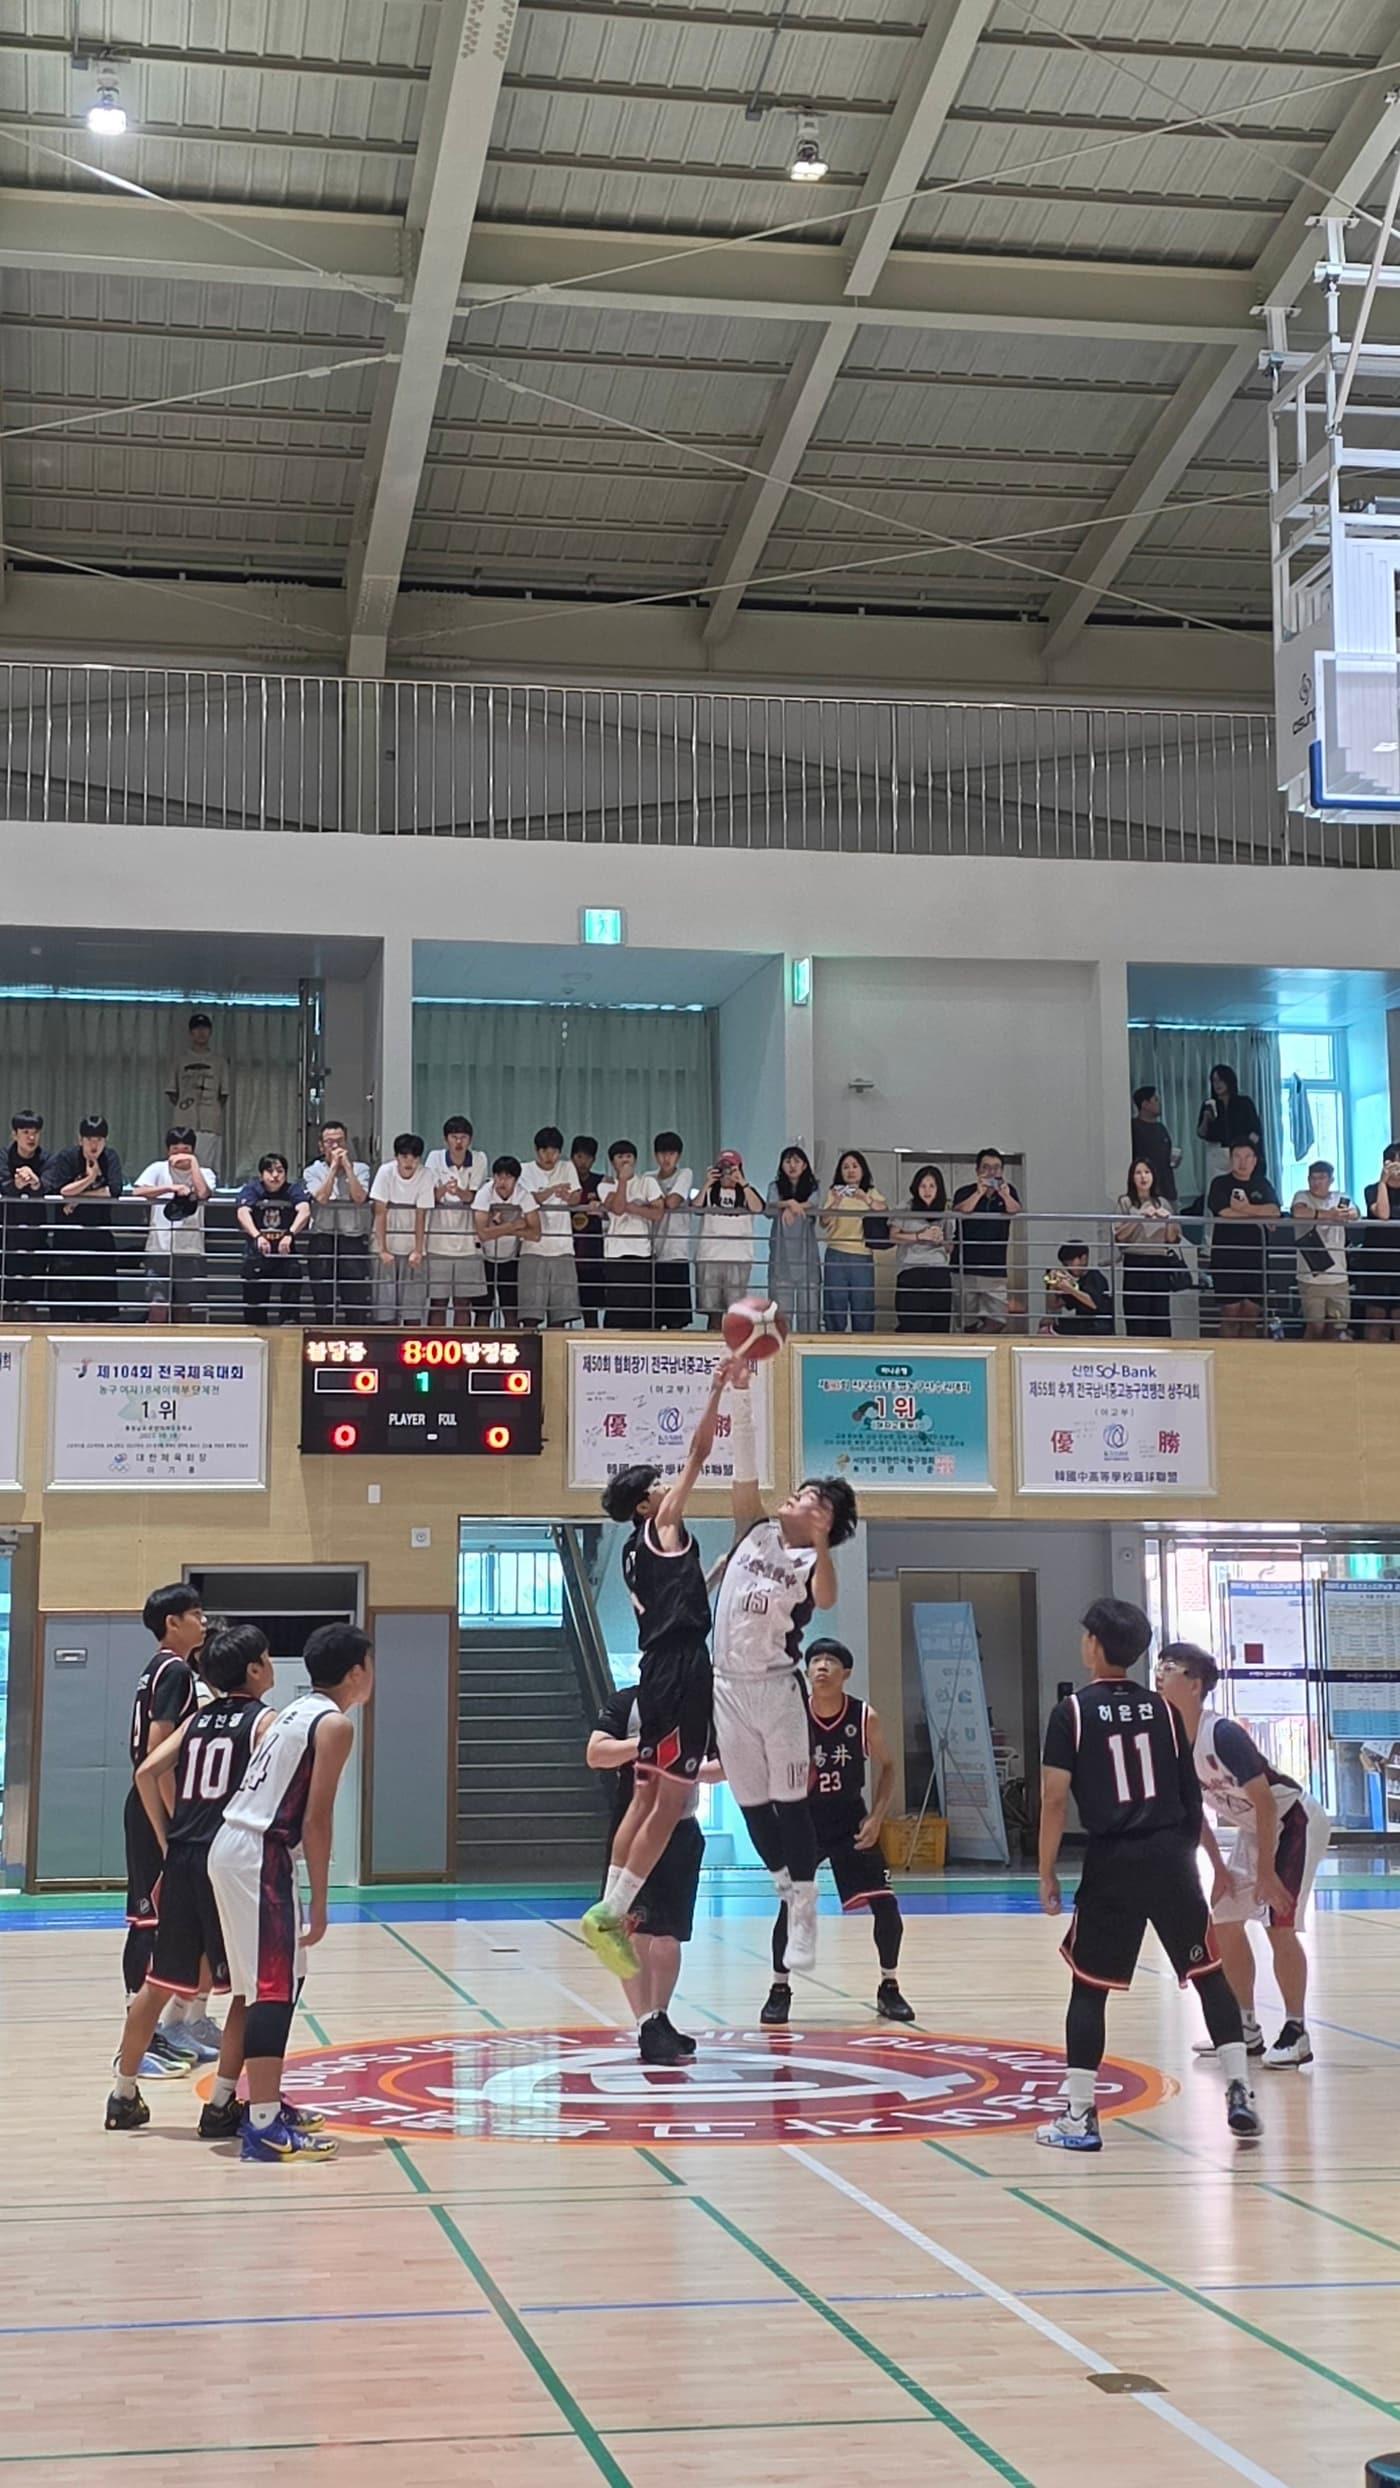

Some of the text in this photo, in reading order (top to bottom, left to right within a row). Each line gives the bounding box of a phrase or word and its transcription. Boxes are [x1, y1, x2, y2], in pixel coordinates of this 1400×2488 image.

[402, 1340, 461, 1365] 8:00
[97, 1364, 244, 1380] 제104회 전국체육대회
[583, 1355, 611, 1374] 제50회
[1071, 1365, 1094, 1378] 신한
[1121, 1365, 1157, 1379] Bank
[355, 1371, 376, 1392] 0
[415, 1371, 430, 1393] 1
[508, 1372, 529, 1393] 0
[388, 1413, 457, 1426] PLAYER FOUL
[603, 1413, 628, 1438] 優
[333, 1425, 357, 1447] 0
[488, 1426, 511, 1449] 0
[1051, 1430, 1181, 1455] 優 勝
[182, 1737, 234, 1800] 10
[1108, 1732, 1157, 1803] 11
[819, 1770, 843, 1793] 23
